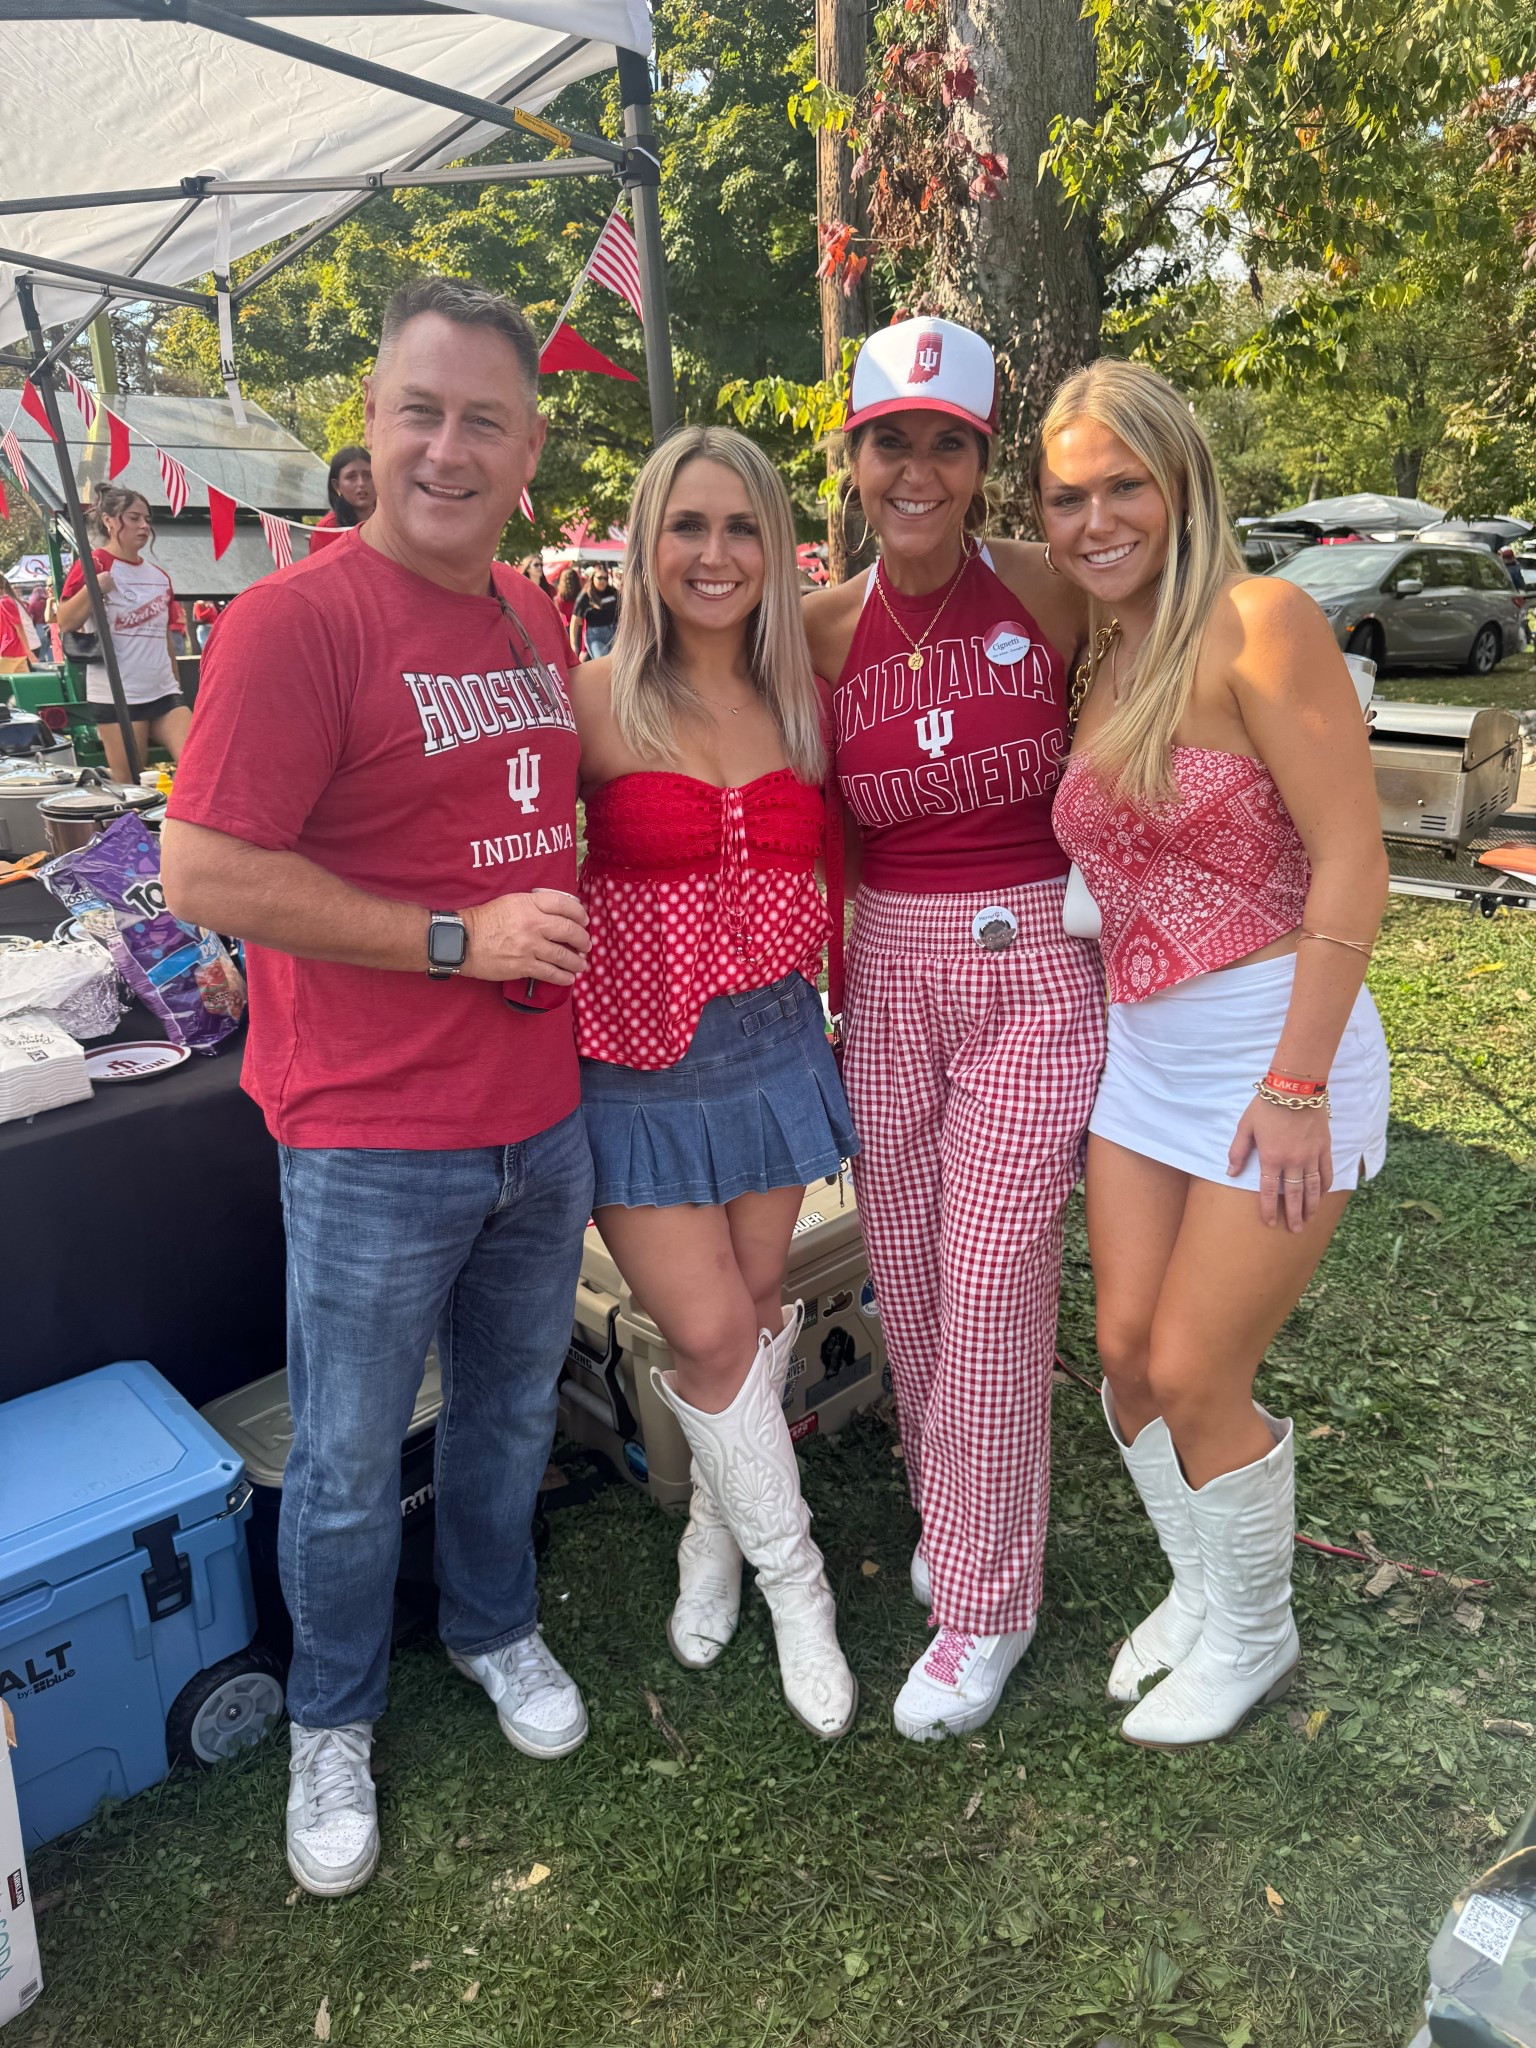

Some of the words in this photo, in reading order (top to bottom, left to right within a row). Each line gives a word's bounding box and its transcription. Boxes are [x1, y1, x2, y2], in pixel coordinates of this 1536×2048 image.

[992, 636, 1020, 651] Cignetti
[833, 636, 1056, 754] INDIANA
[837, 728, 1065, 828] HOOSIERS
[470, 823, 574, 868] INDIANA
[103, 1058, 171, 1077] INDIAN
[1273, 1077, 1300, 1092] LAKE
[0, 1640, 73, 1698] ALT
[45, 1668, 77, 1689] blue
[12, 1869, 25, 1906] KIRKLAND
